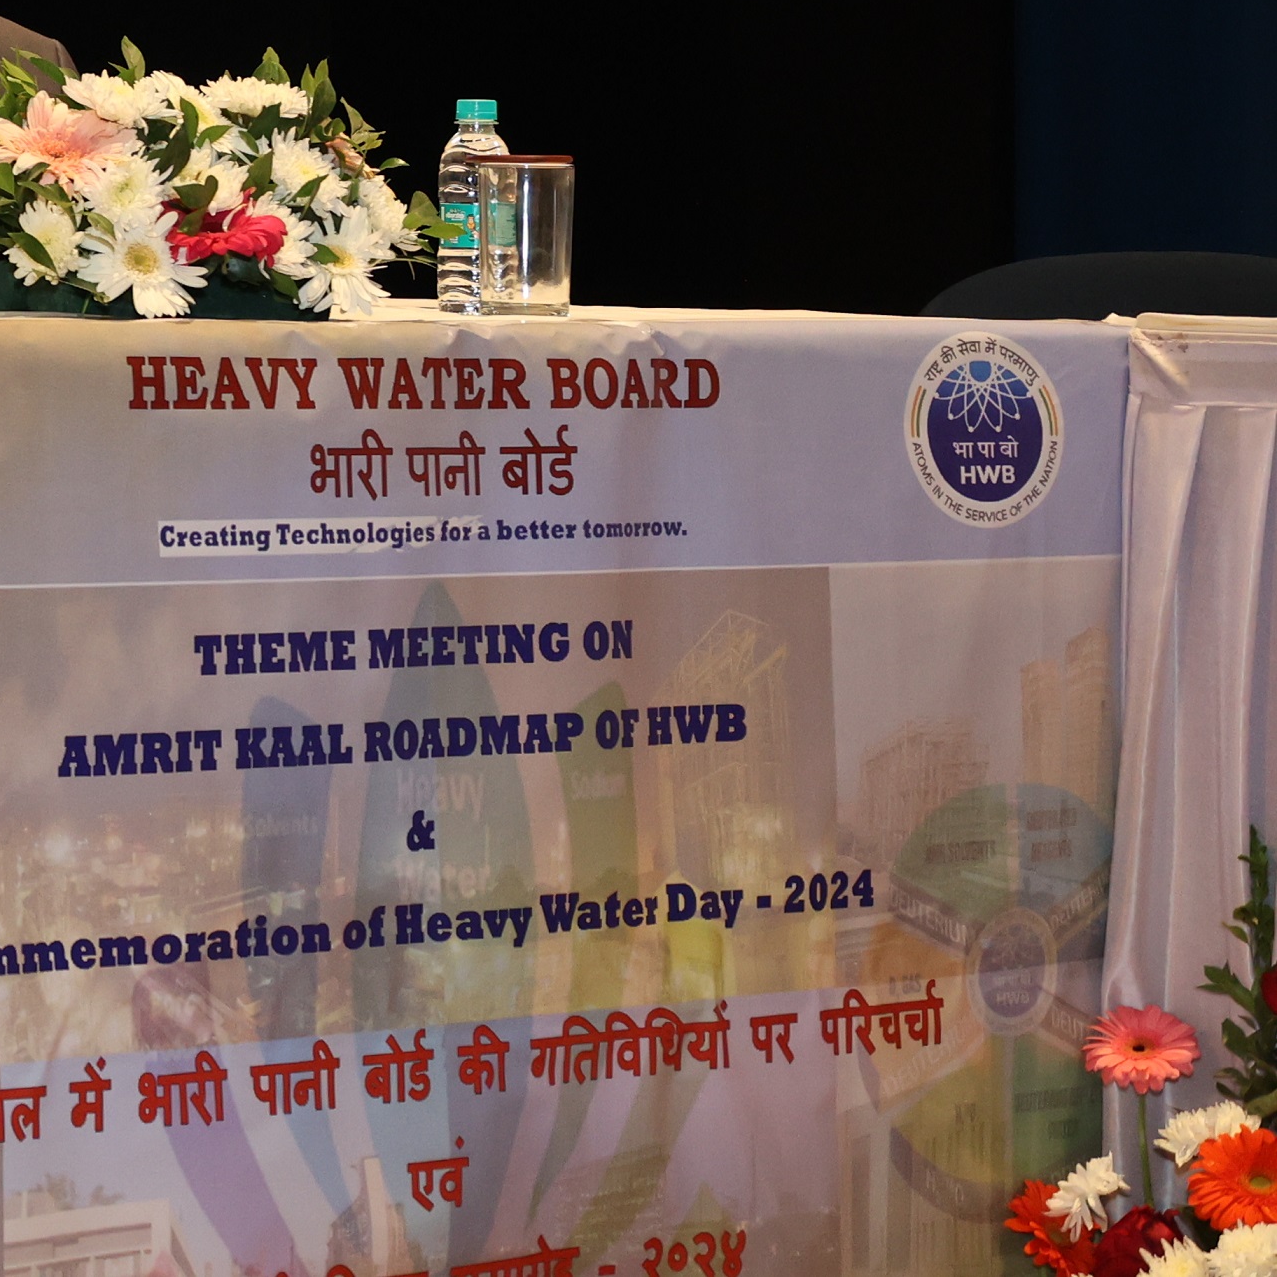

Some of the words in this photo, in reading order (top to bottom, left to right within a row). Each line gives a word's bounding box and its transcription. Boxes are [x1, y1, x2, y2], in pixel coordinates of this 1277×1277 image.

[126, 356, 317, 409] HEAVY
[338, 357, 530, 409] WATER
[547, 358, 719, 409] BOARD
[924, 361, 943, 382] राष्ट्र
[940, 345, 957, 363] की
[957, 339, 981, 355] सेवा
[984, 337, 997, 354] में
[999, 345, 1040, 387] परमाणु
[311, 429, 393, 500] भारी
[406, 431, 485, 496] पानी
[500, 425, 577, 495] बोर्ड
[912, 442, 934, 486] ATOMS
[932, 484, 944, 499] IN
[944, 496, 963, 515] THE
[965, 509, 1008, 522] SERVICE
[1010, 503, 1024, 516] OF
[1023, 486, 1042, 506] THE
[1038, 441, 1058, 488] NATION
[960, 466, 1016, 484] HWB
[160, 525, 270, 551] Creating
[276, 522, 434, 548] Technologies
[441, 521, 471, 541] for
[478, 526, 490, 540] a
[497, 520, 576, 540] better
[583, 520, 687, 538] tomorrow.
[194, 630, 356, 675] THEME
[369, 623, 569, 668] MEETING
[583, 620, 632, 660] ON
[58, 730, 221, 777] AMRIT
[235, 724, 352, 769] KAAL
[365, 713, 584, 762] ROADMAP
[596, 709, 639, 749] OF
[647, 704, 746, 745] HWB
[407, 810, 434, 851] &
[343, 906, 385, 949] of
[395, 904, 532, 947] Heavy
[540, 891, 657, 933] Water
[666, 884, 743, 928] Day
[784, 869, 873, 913] 2024
[69, 1057, 111, 1132] में
[138, 1041, 227, 1126] भारी
[250, 1040, 340, 1115] पानी
[363, 1029, 434, 1103] बोर्ड
[457, 1025, 510, 1095] की
[530, 1000, 730, 1085] गतिविधियों
[750, 1013, 798, 1064] पर
[820, 979, 944, 1055] परिचर्चा
[407, 1136, 469, 1212] एवं
